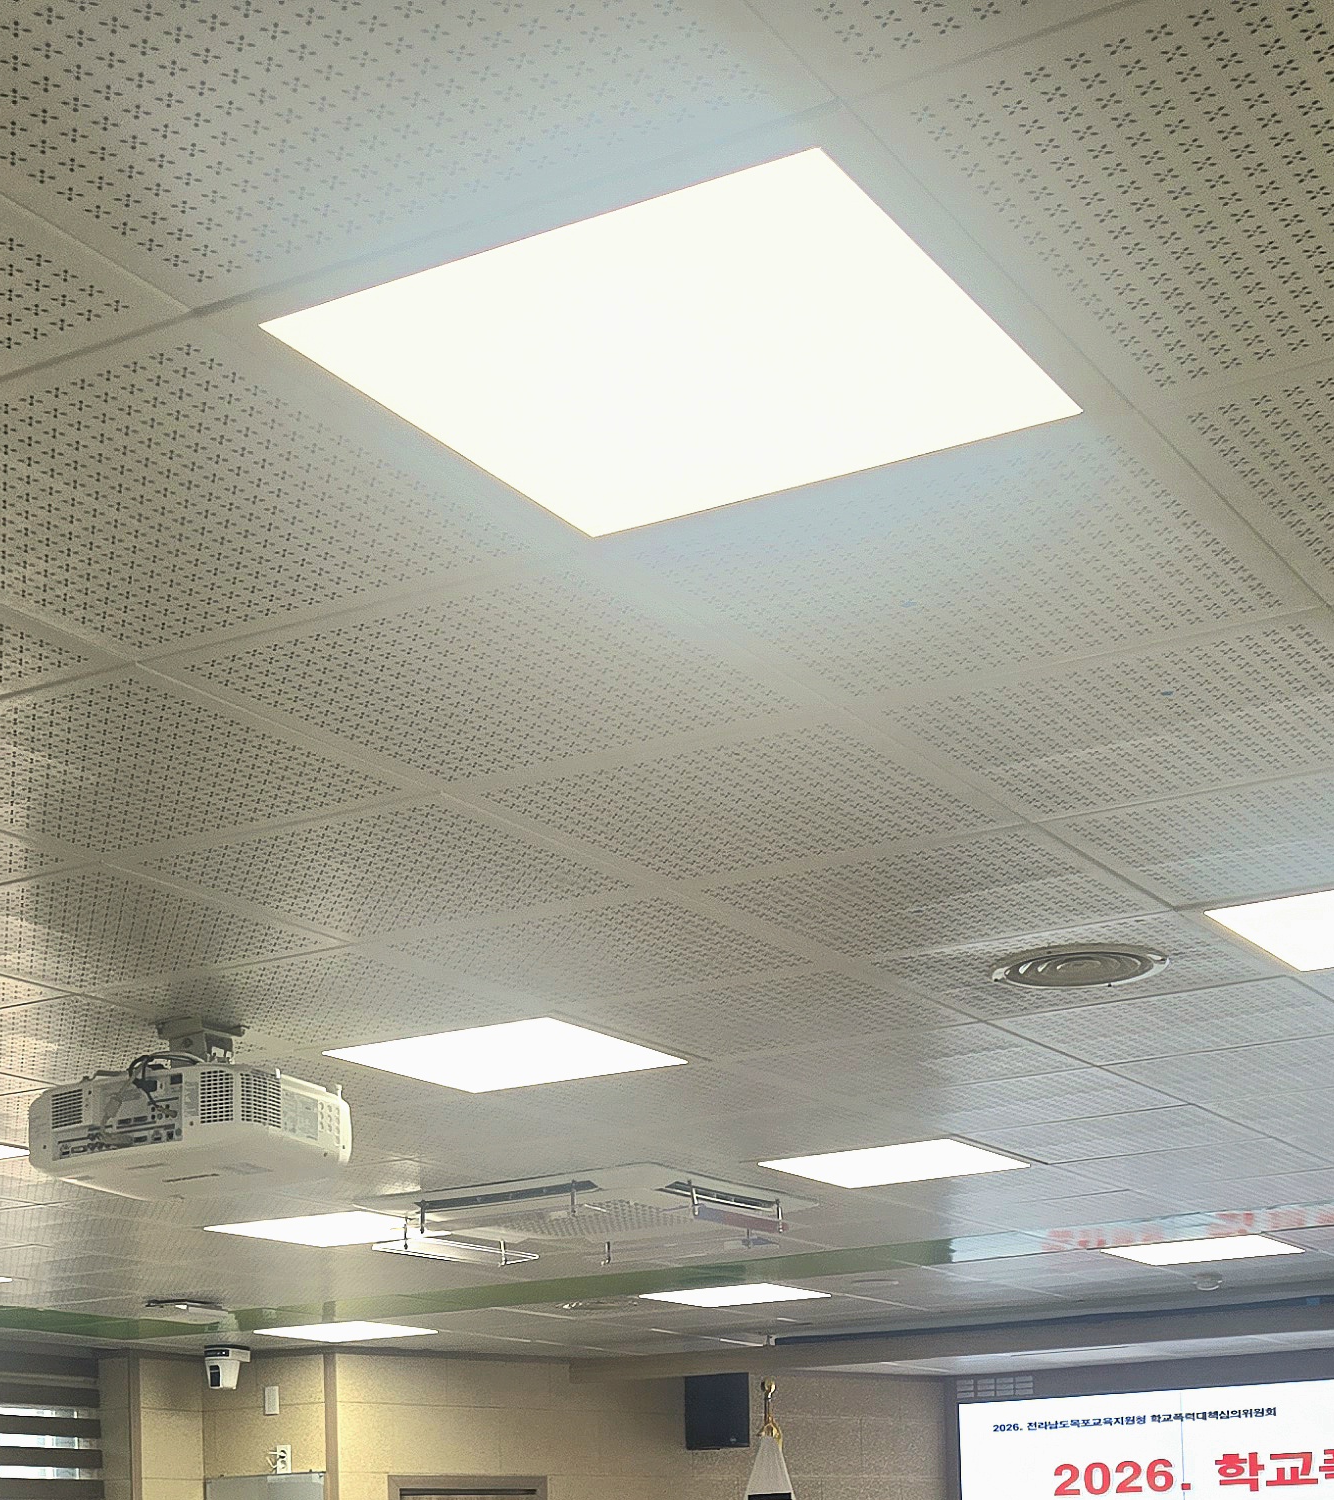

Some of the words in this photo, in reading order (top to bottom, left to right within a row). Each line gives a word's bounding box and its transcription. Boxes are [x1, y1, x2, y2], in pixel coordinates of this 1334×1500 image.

[993, 1423, 1023, 1432] 2026.
[1026, 1415, 1147, 1431] 전라남도목포교육지원청
[1150, 1407, 1277, 1423] 학교폭력대책심의위원회
[1053, 1458, 1192, 1496] 2026.
